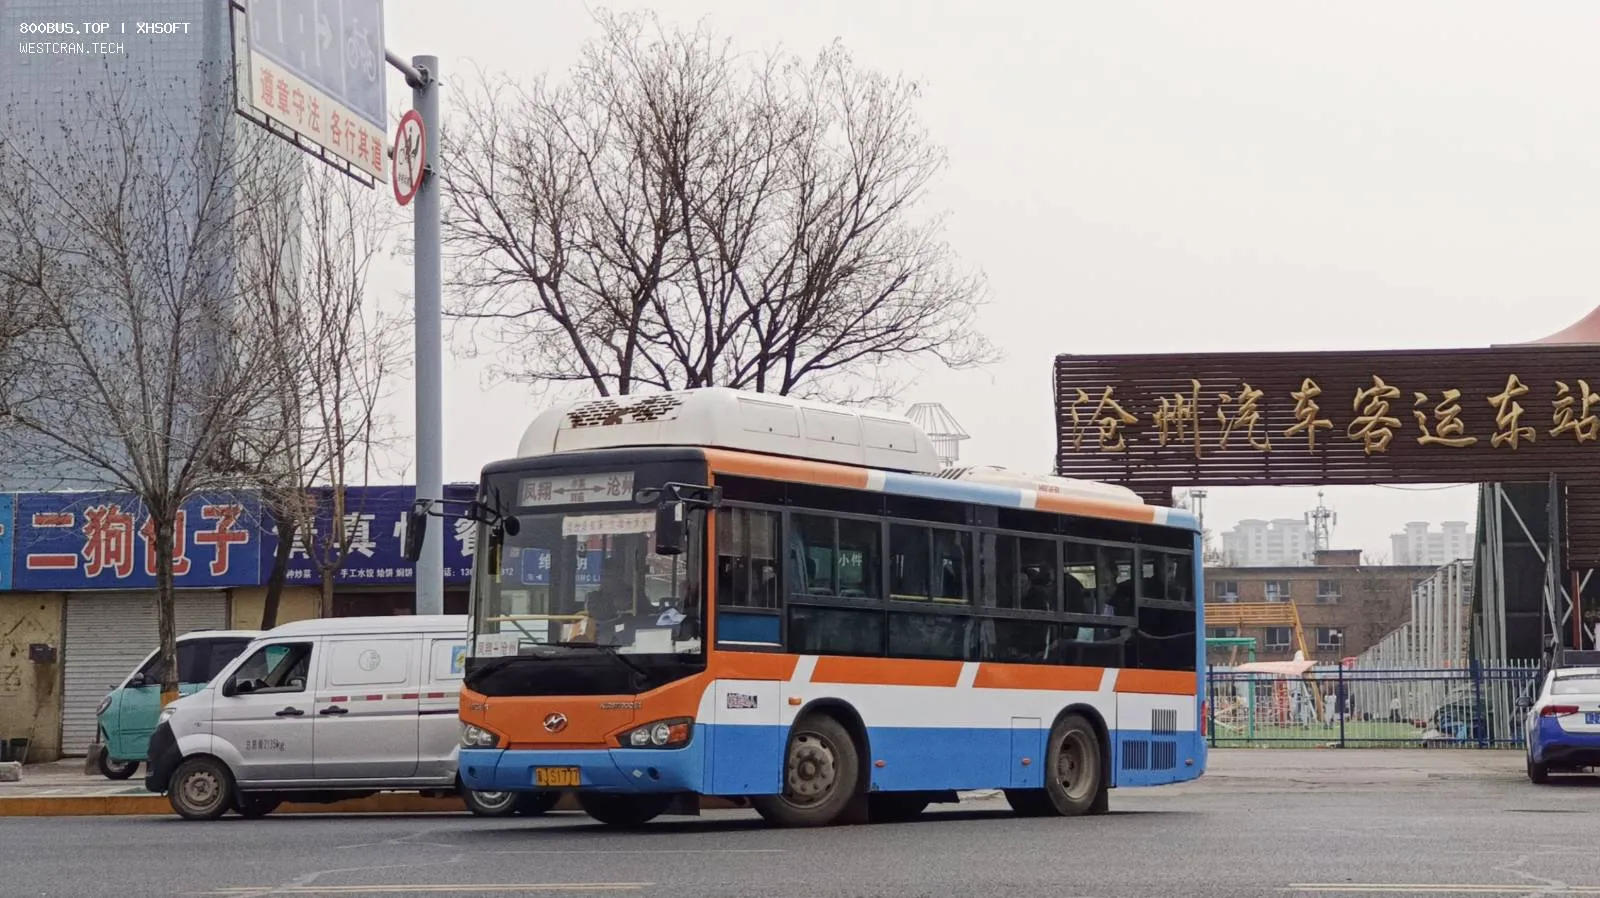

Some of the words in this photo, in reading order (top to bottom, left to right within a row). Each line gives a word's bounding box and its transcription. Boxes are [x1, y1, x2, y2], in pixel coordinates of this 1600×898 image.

[260, 67, 321, 133] 遵章守法
[330, 110, 382, 172] 各行其道
[1072, 374, 1600, 458] 沧州汽车客运东站
[26, 503, 249, 578] 二狗包子
